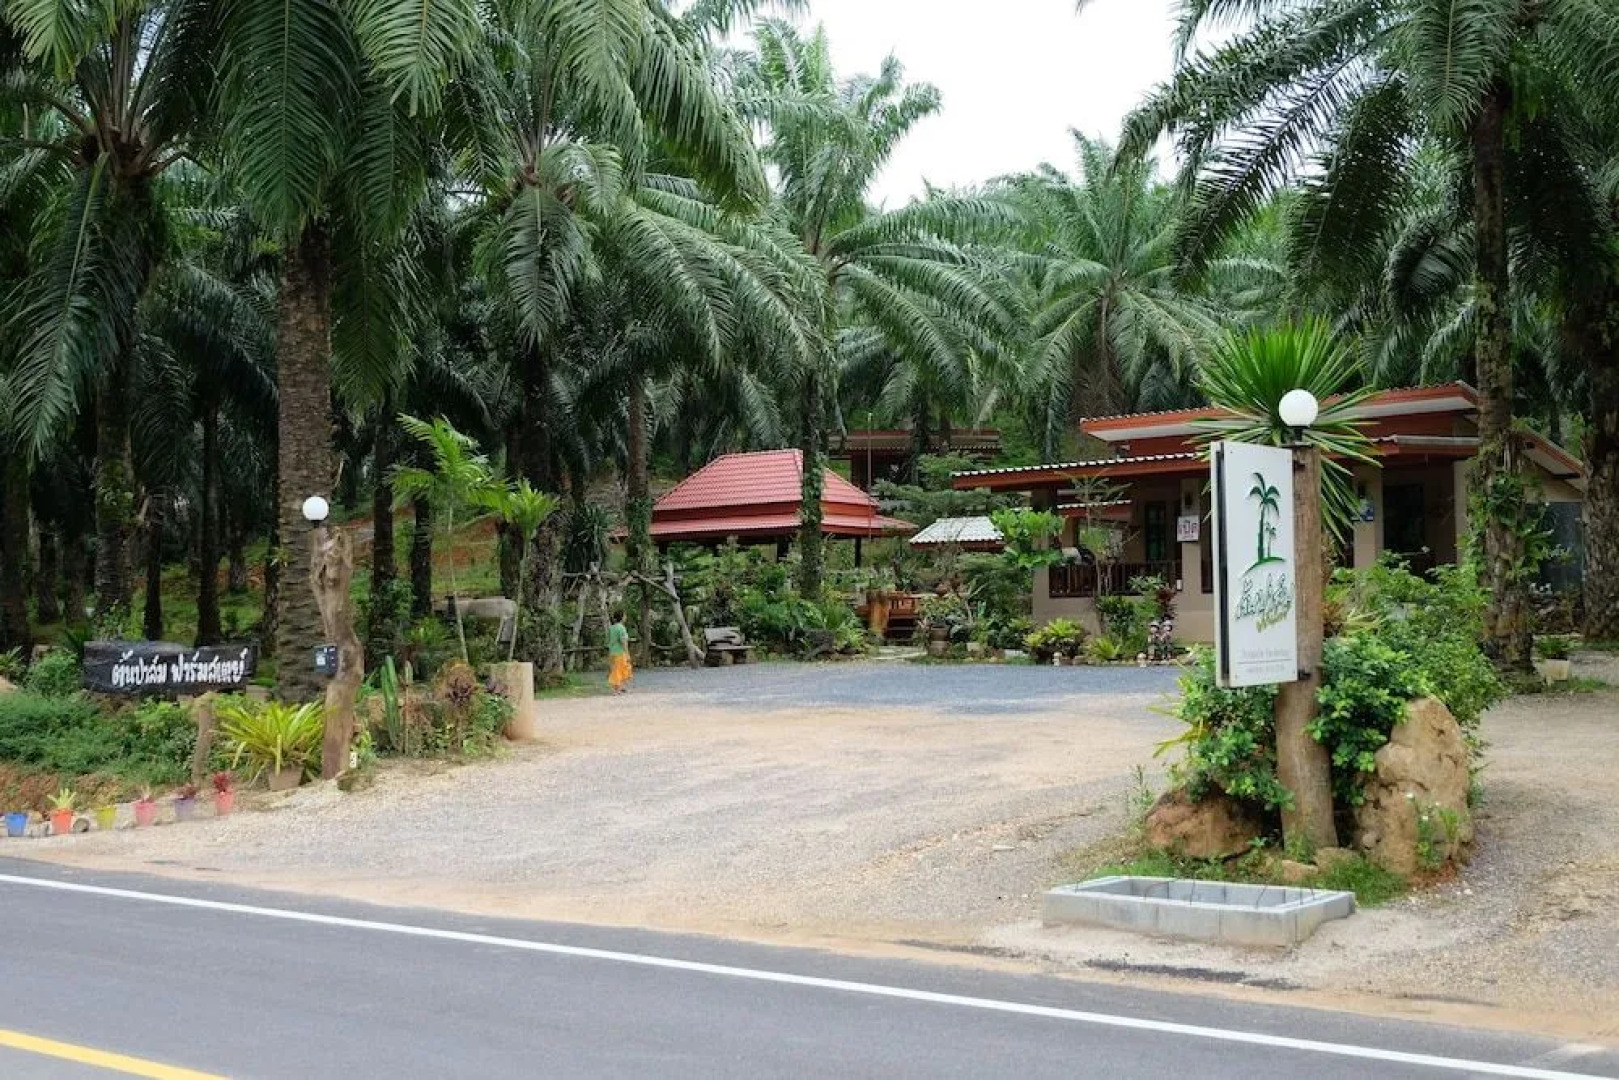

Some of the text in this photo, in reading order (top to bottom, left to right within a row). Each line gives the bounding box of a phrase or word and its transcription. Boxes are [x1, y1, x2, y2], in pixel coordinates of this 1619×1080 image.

[111, 648, 248, 687] ต้นปาล์ม ฟาร์มสเตย์
